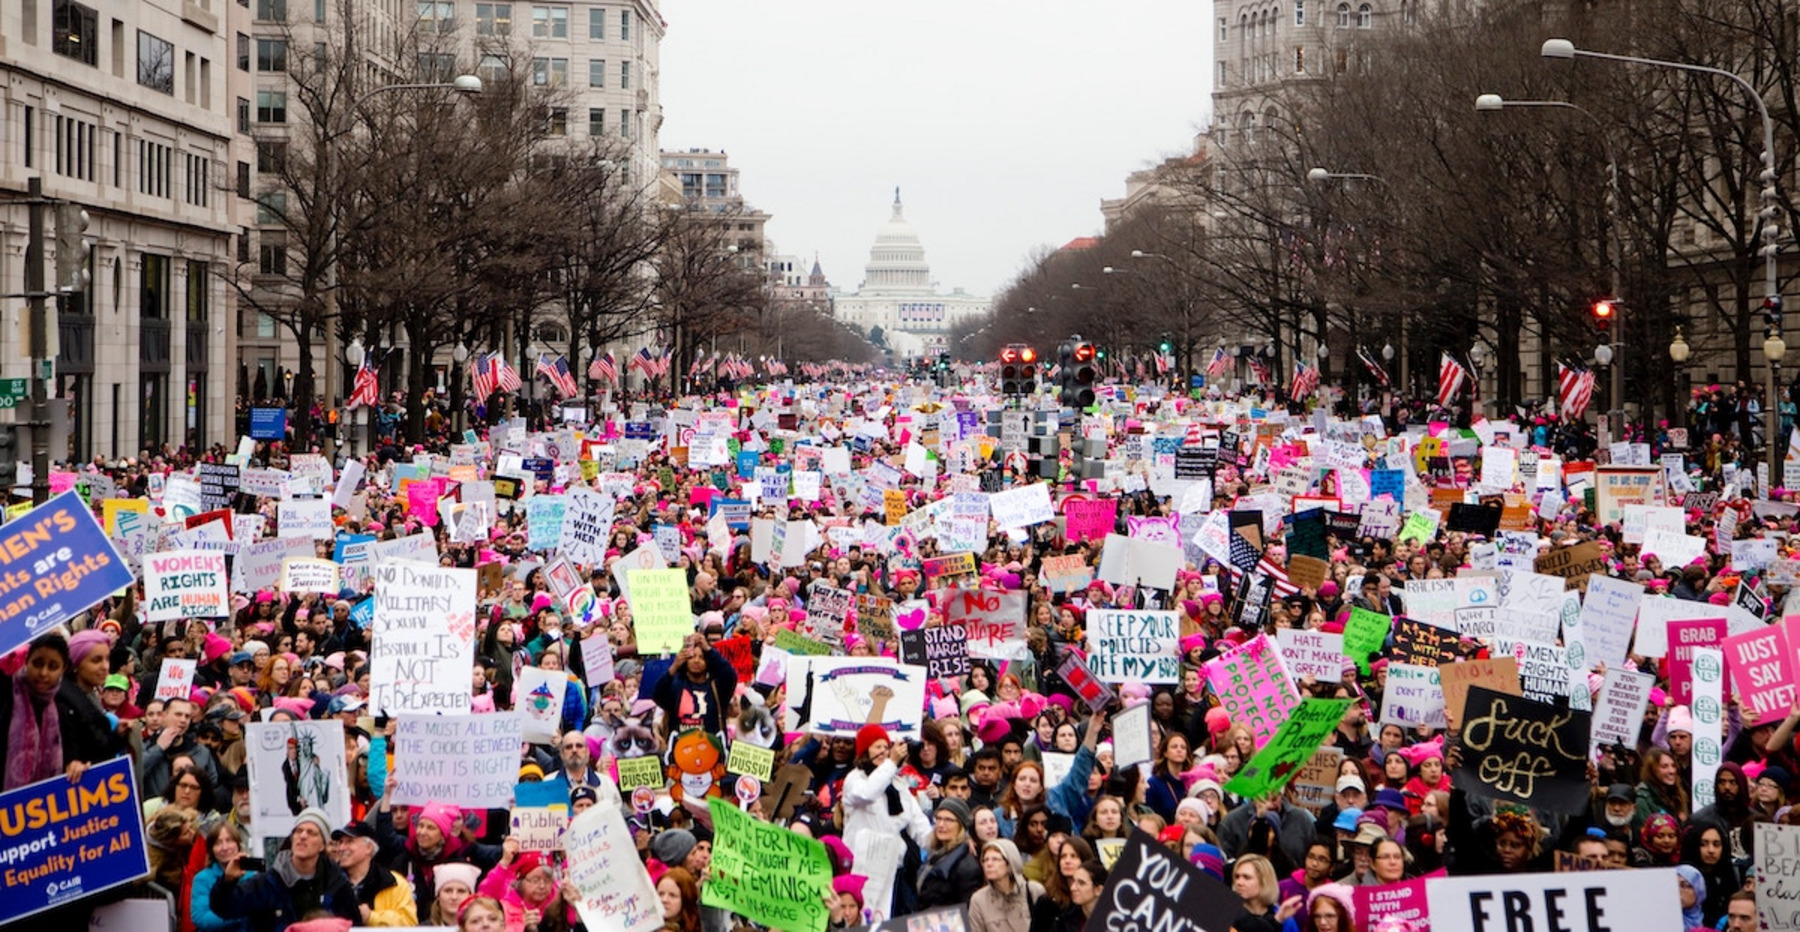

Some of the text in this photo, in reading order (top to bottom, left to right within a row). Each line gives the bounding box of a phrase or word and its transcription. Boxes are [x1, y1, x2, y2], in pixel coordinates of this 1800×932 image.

[581, 512, 596, 524] I'M
[573, 520, 601, 536] WITH
[574, 530, 595, 545] HER
[33, 547, 73, 575] are
[944, 562, 972, 573] STAND
[34, 552, 110, 599] Rights
[161, 573, 217, 591] RIGHTS
[377, 567, 396, 583] NO
[1406, 580, 1455, 593] RACISM
[150, 593, 221, 612] ARE HUMAN
[375, 586, 453, 613] MILITARY
[181, 605, 218, 617] RIGHTS
[352, 605, 373, 624] WE
[1458, 610, 1495, 621] WHY I
[924, 626, 966, 643] STAND
[1098, 613, 1176, 639] KEEP YOUR
[1293, 634, 1323, 648] HATE
[1416, 630, 1441, 645] I'M
[1679, 627, 1717, 643] GRAB
[926, 643, 968, 659] MARCH
[1100, 638, 1161, 655] POLICIES
[1411, 643, 1441, 657] WITH
[1737, 635, 1780, 665] JUST
[1090, 654, 1156, 678] OFF MY
[1312, 651, 1341, 664] MAKE
[1409, 654, 1438, 668] HER
[168, 665, 185, 680] We
[395, 659, 440, 683] NOT
[929, 658, 971, 676] RISE
[1295, 662, 1335, 676] GREAT!
[1388, 667, 1414, 680] MEN
[1523, 661, 1569, 681] RIGHTS
[1748, 661, 1783, 688] SAY
[1523, 676, 1569, 697] HUMAN
[1620, 674, 1637, 683] TOO
[158, 679, 188, 698] won't
[1241, 652, 1288, 728] WILL NOT
[1395, 687, 1424, 697] DON'T
[1608, 690, 1641, 702] THINGS
[1613, 682, 1641, 693] MANY
[1225, 662, 1271, 738] PROTECT
[1607, 698, 1638, 710] WRONG
[1750, 683, 1797, 714] NYET
[1609, 716, 1628, 725] ONE
[1611, 708, 1628, 717] FOR
[398, 718, 521, 736] WE MUST ALL FACE
[1601, 723, 1631, 735] SMALL
[399, 736, 521, 755] THE CHOICE BETWEEN
[403, 756, 512, 776] WHAT IS RIGHT
[730, 756, 770, 778] PUSSY!
[622, 768, 662, 788] PUSSY!
[1299, 769, 1321, 781] GET
[394, 781, 516, 798] AND WHAT IS EASY
[0, 773, 130, 840] USLIMS
[61, 814, 120, 843] Justice
[521, 812, 564, 829] Public
[569, 824, 609, 851] Super
[755, 827, 783, 852] FOR
[786, 834, 811, 858] MY
[5, 831, 131, 888] Equality for All
[798, 858, 820, 875] ME
[1136, 844, 1190, 902] YOU
[59, 875, 82, 892] CAIR
[741, 862, 823, 904] FEMINISM
[1369, 887, 1412, 902] I STAND
[760, 902, 799, 921] PEACE
[1113, 879, 1207, 932] CAN'T
[1369, 901, 1401, 912] WITH
[1468, 886, 1610, 932] FREE
